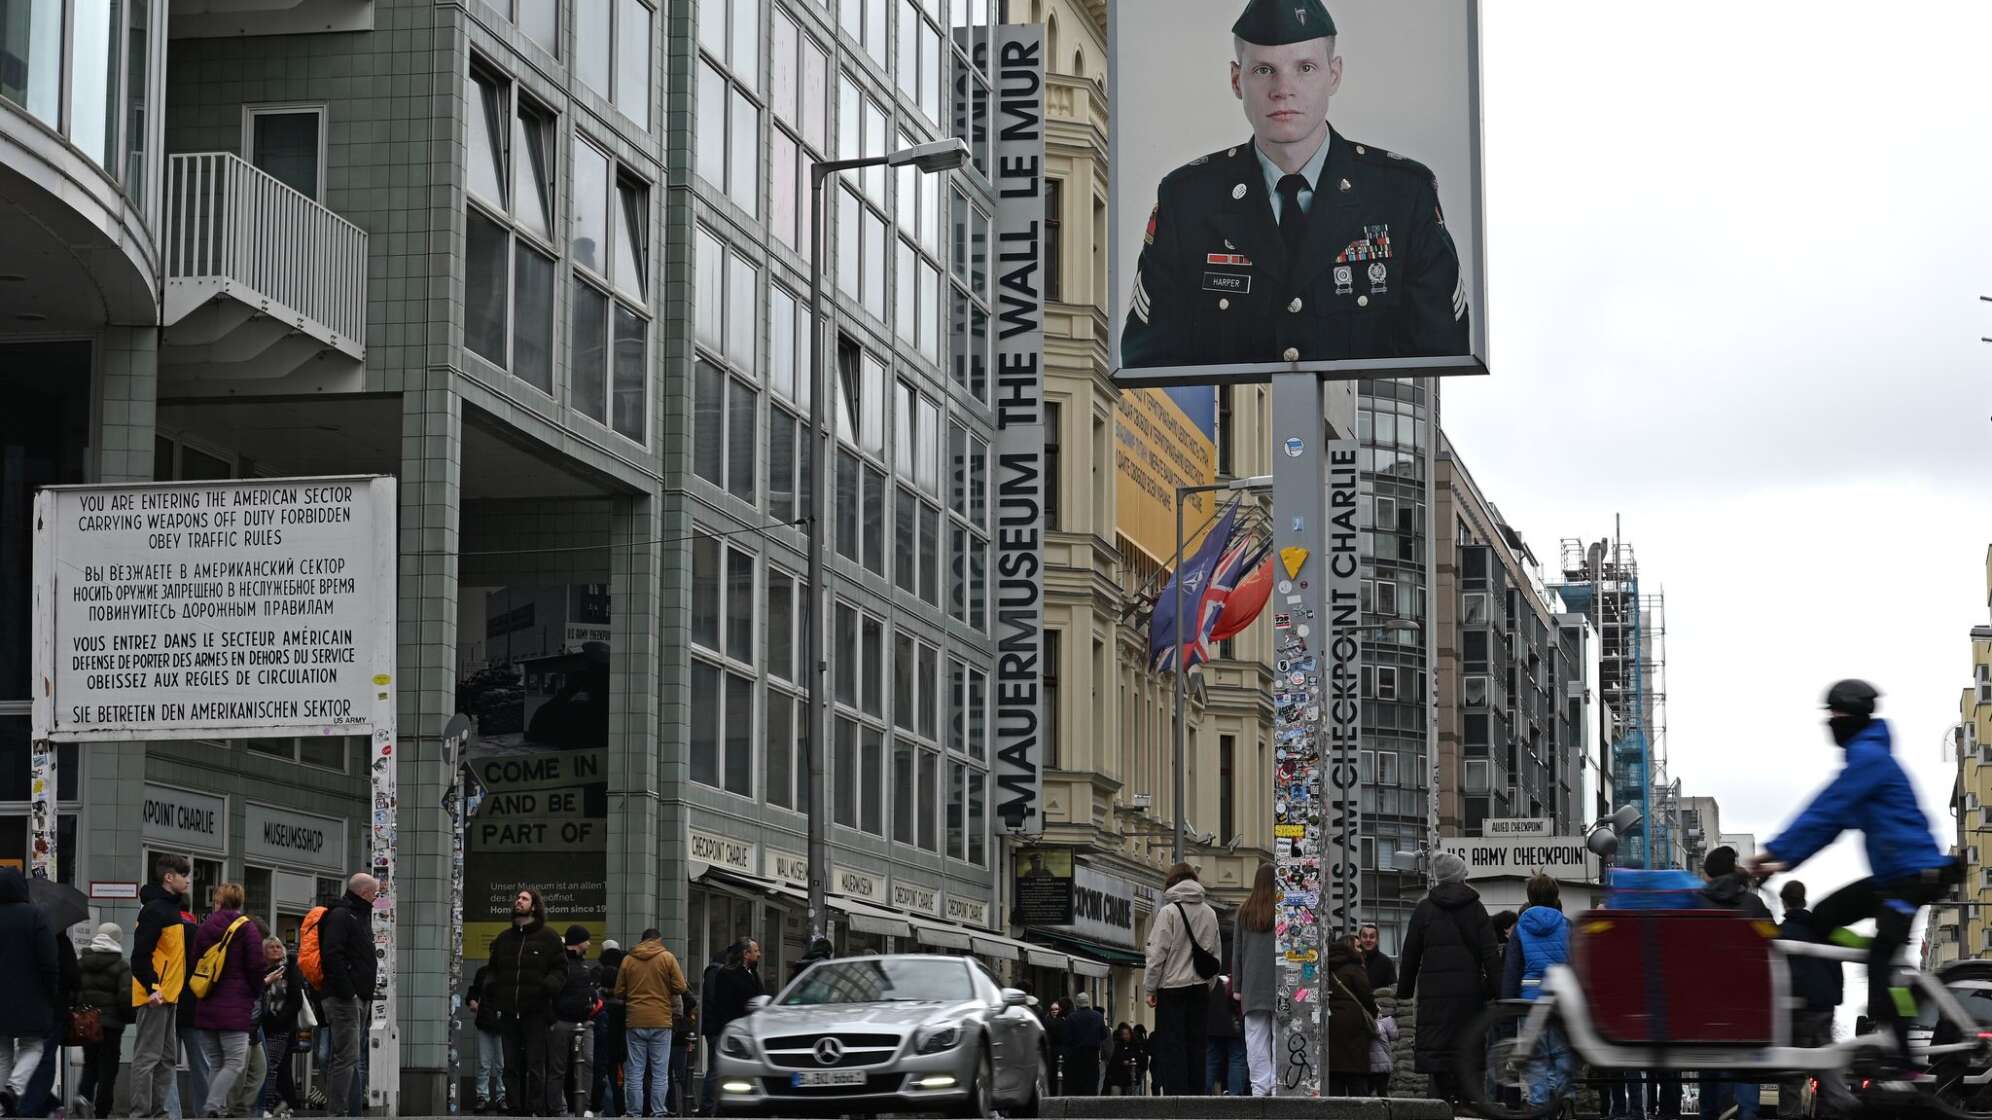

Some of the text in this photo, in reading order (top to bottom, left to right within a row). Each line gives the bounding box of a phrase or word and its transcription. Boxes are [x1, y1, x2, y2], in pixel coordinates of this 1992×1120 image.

[1213, 277, 1240, 288] HARPER
[997, 39, 1039, 819] MAUERMUSEUM THE WALL LE MUR
[80, 486, 352, 511] YOU ARE ENTERING THE AMERICAN SECTOR
[78, 507, 350, 531] CARRYING WEAPONS OFF DUTY FORBIDDEN
[1331, 450, 1357, 578] CHARLIE
[148, 529, 281, 549] OBEY TRAFFIC RULES
[85, 566, 103, 581] ВЫ
[180, 563, 187, 579] В
[194, 557, 294, 578] АМЕРИКАНСКИЙ
[300, 558, 345, 575] СЕКТОР
[73, 586, 113, 602] НОСИТЬ
[116, 584, 159, 600] ОРУЖИЕ
[228, 582, 235, 597] В
[240, 579, 315, 597] НЕСЛУЖЕБНОЕ
[320, 578, 354, 594] ВРЕМЯ
[182, 601, 256, 618] ДОРОЖНЫМ
[264, 599, 334, 616] ПРАВИЛАМ
[73, 635, 105, 651] VOUS
[114, 634, 156, 650] ENTREZ
[164, 633, 196, 648] DANS
[204, 632, 214, 647] LE
[221, 631, 275, 647] SECTEUR
[73, 648, 355, 670] DEFENSE DE PORTER DES ARMES EN DEHORS DU SERVICE
[87, 668, 337, 689] OBEISSEZ AUX REGLES DE CIRCULATION
[1332, 589, 1358, 790] CHECKPOINT
[73, 699, 351, 723] SIE BETRETEN DEN AMERIKANISCHEN SEKTOR
[485, 754, 598, 783] COME IN
[488, 793, 576, 816] AND BE
[177, 805, 214, 834] CHARLIE
[1332, 800, 1357, 853] AM
[1491, 821, 1544, 832] ALLIED CHECKPOINT
[264, 820, 323, 853] MUSEUMSSHOP
[482, 822, 593, 844] PART OF
[692, 835, 747, 867] CHECKPOINT CHARLIE
[1472, 847, 1508, 865] ARMY
[776, 857, 789, 877] WALL
[490, 882, 515, 890] Unser
[556, 881, 566, 890] ist
[841, 873, 873, 897] MAUERMUSEUM
[571, 904, 594, 913] since
[895, 886, 934, 911] CHECKPOINT CHARLIE
[948, 898, 983, 922] CHECKPOINT CHARLIE
[1104, 892, 1131, 929] CHARLIE
